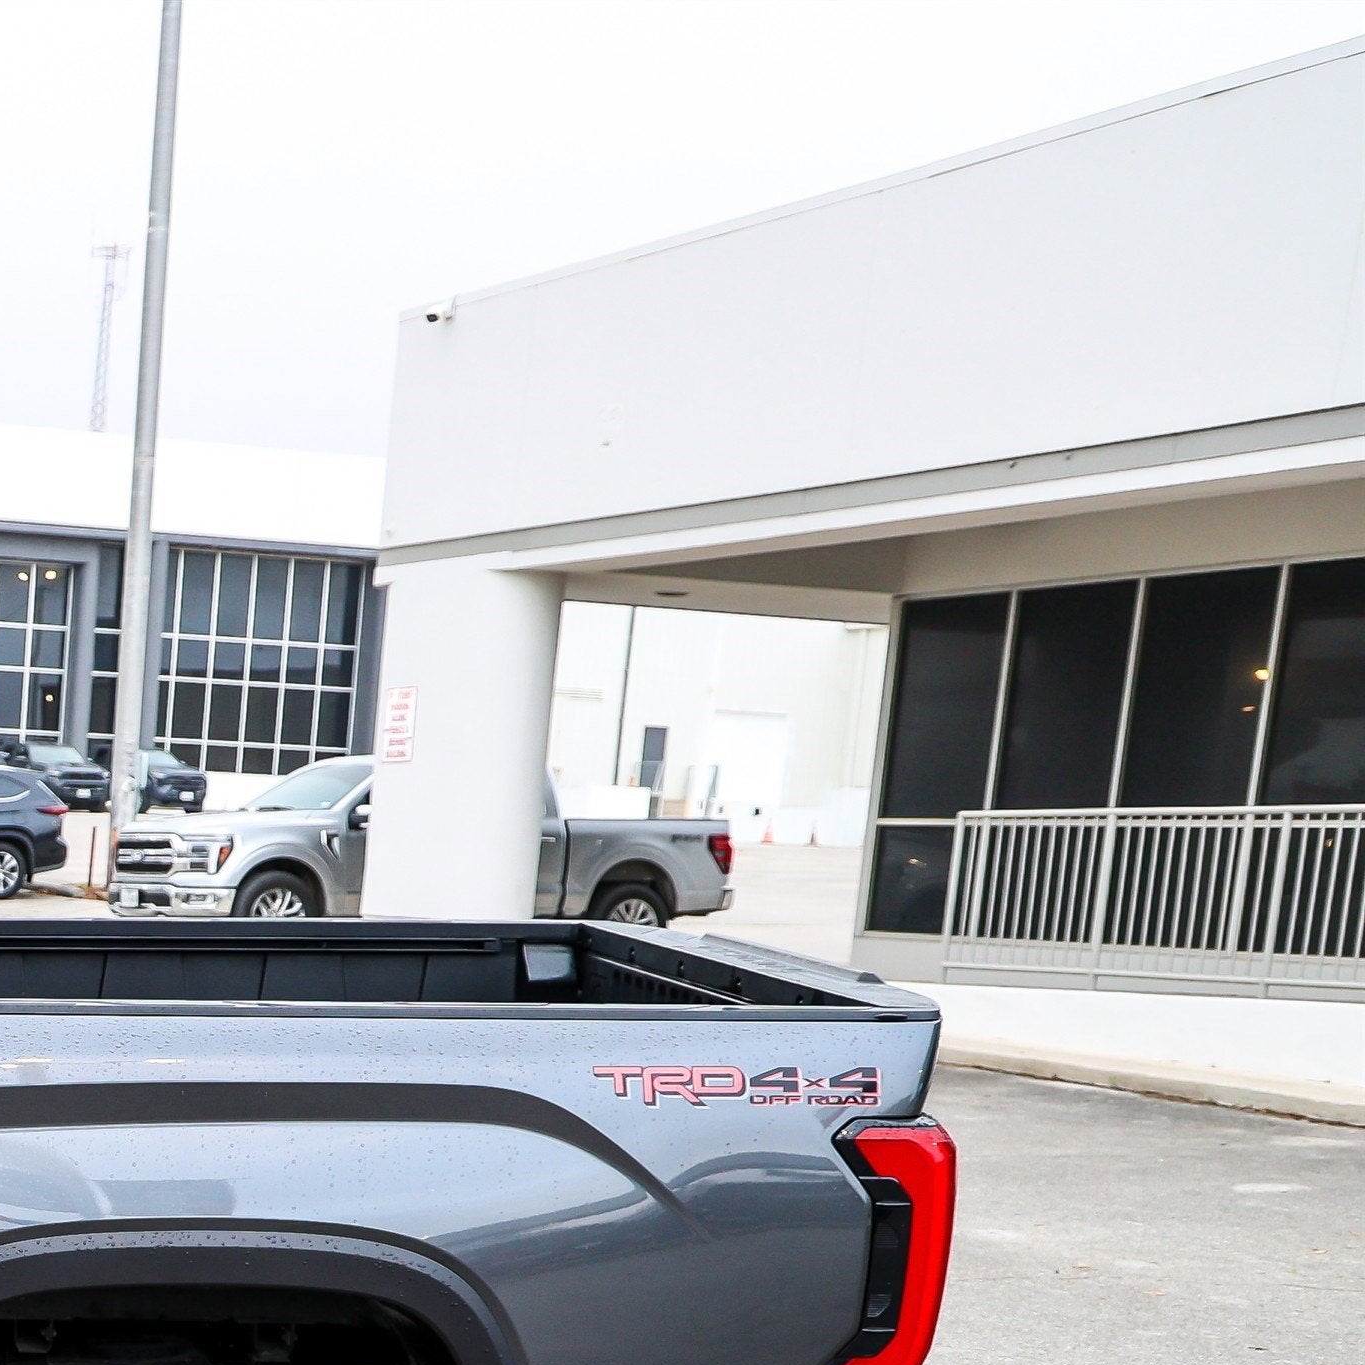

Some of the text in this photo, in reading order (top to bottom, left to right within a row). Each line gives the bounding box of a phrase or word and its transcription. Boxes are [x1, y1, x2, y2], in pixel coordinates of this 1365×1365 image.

[592, 1065, 745, 1107] TRD
[750, 1094, 882, 1107] OFF ROAD
